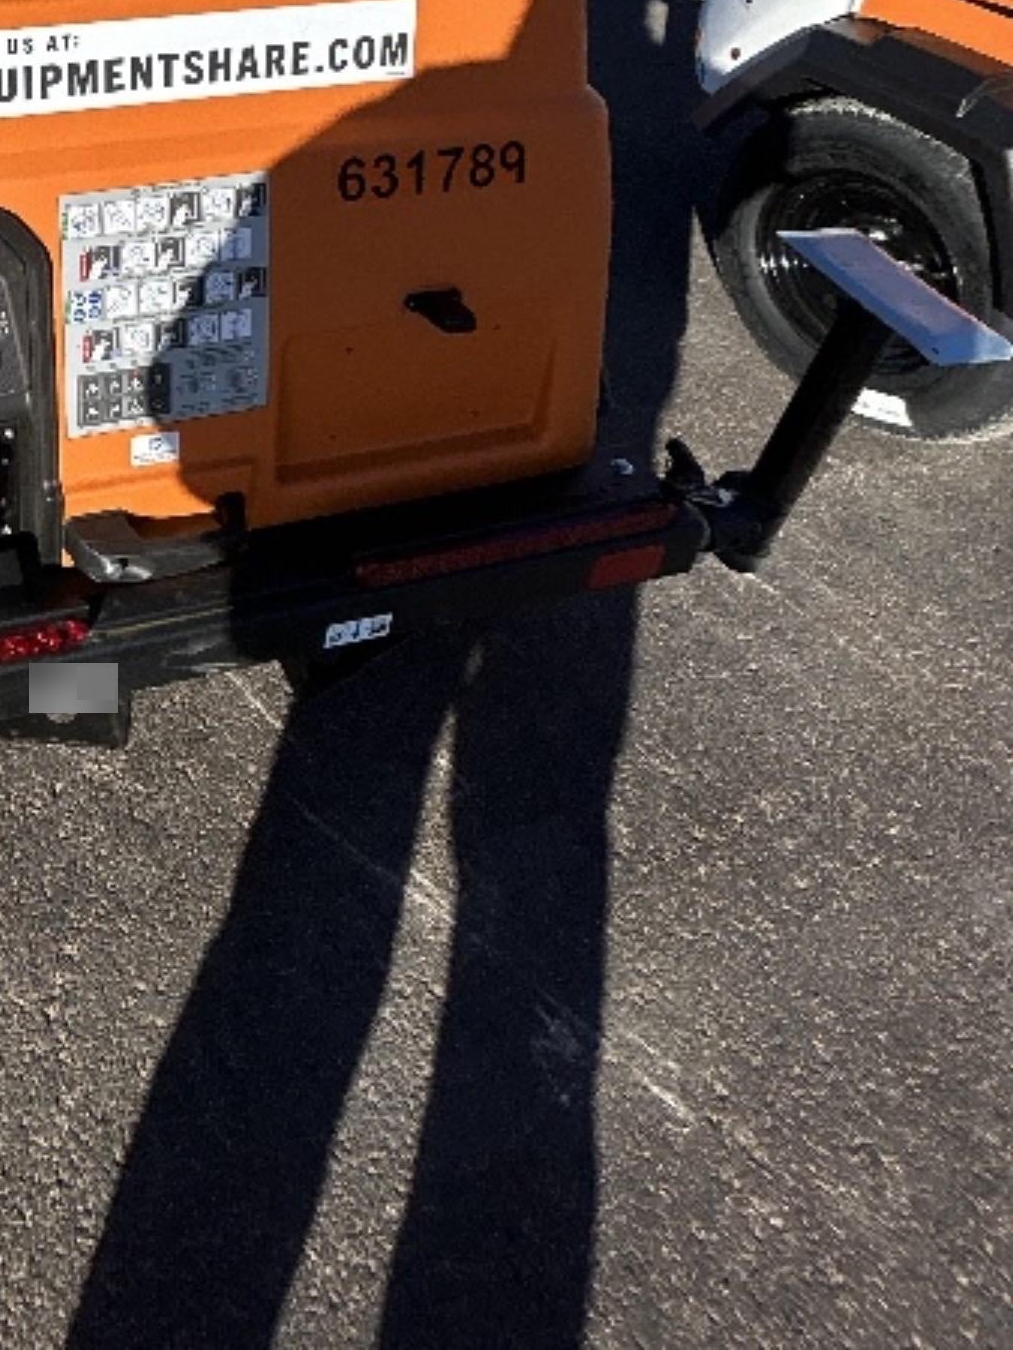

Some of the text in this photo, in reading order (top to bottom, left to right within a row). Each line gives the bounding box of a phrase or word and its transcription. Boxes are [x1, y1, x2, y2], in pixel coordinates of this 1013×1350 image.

[6, 37, 34, 55] US
[46, 33, 80, 52] AT:
[338, 140, 526, 202] 631789
